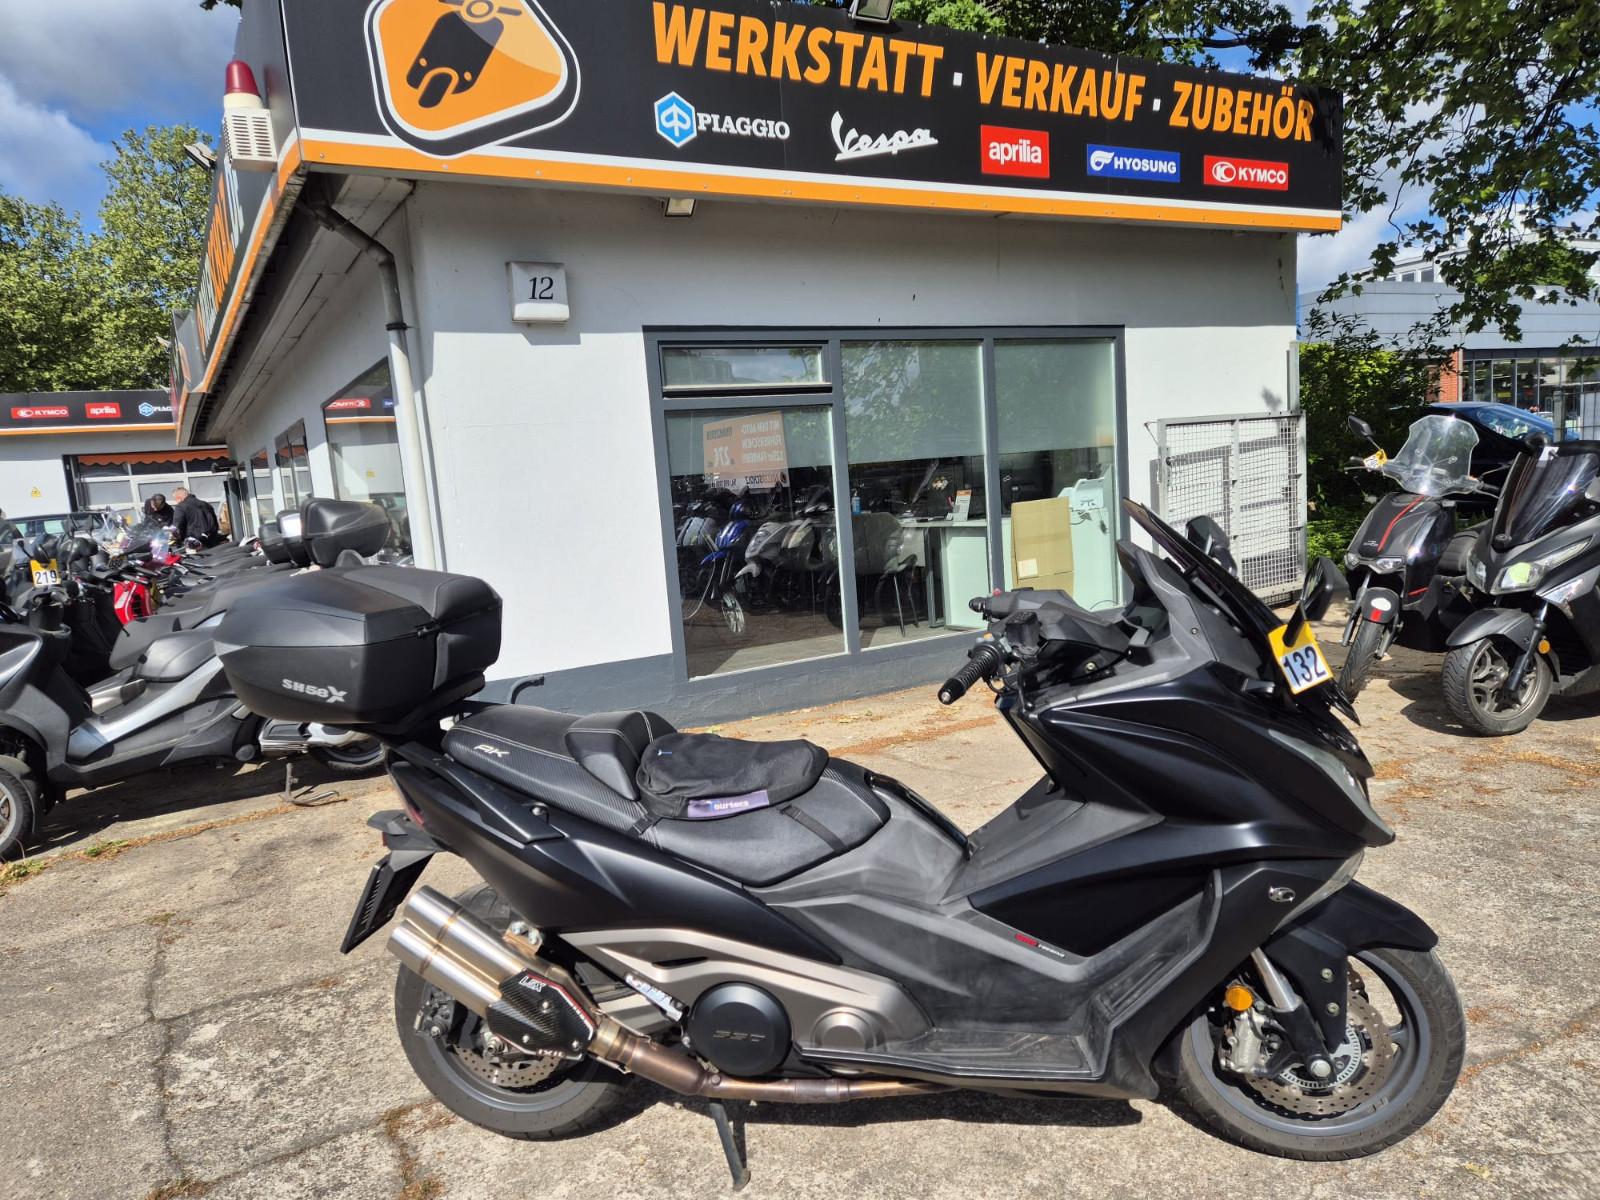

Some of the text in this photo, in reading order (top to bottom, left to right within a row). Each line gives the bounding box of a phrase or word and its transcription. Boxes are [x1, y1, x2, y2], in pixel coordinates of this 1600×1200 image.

[652, 2, 1315, 142] WERKSTATT VERKAUF ZUBEHÖR
[697, 112, 791, 140] PIAGGIO
[831, 110, 938, 161] Vespa
[988, 138, 1042, 166] aprilia
[1113, 155, 1177, 175] HYOSUNG
[1237, 168, 1287, 185] KYMCO
[528, 276, 554, 300] 12
[34, 408, 68, 416] KYMCO
[90, 406, 117, 415] aprilia
[35, 569, 57, 585] 219
[1283, 645, 1328, 687] 132
[281, 678, 348, 703] SH58X
